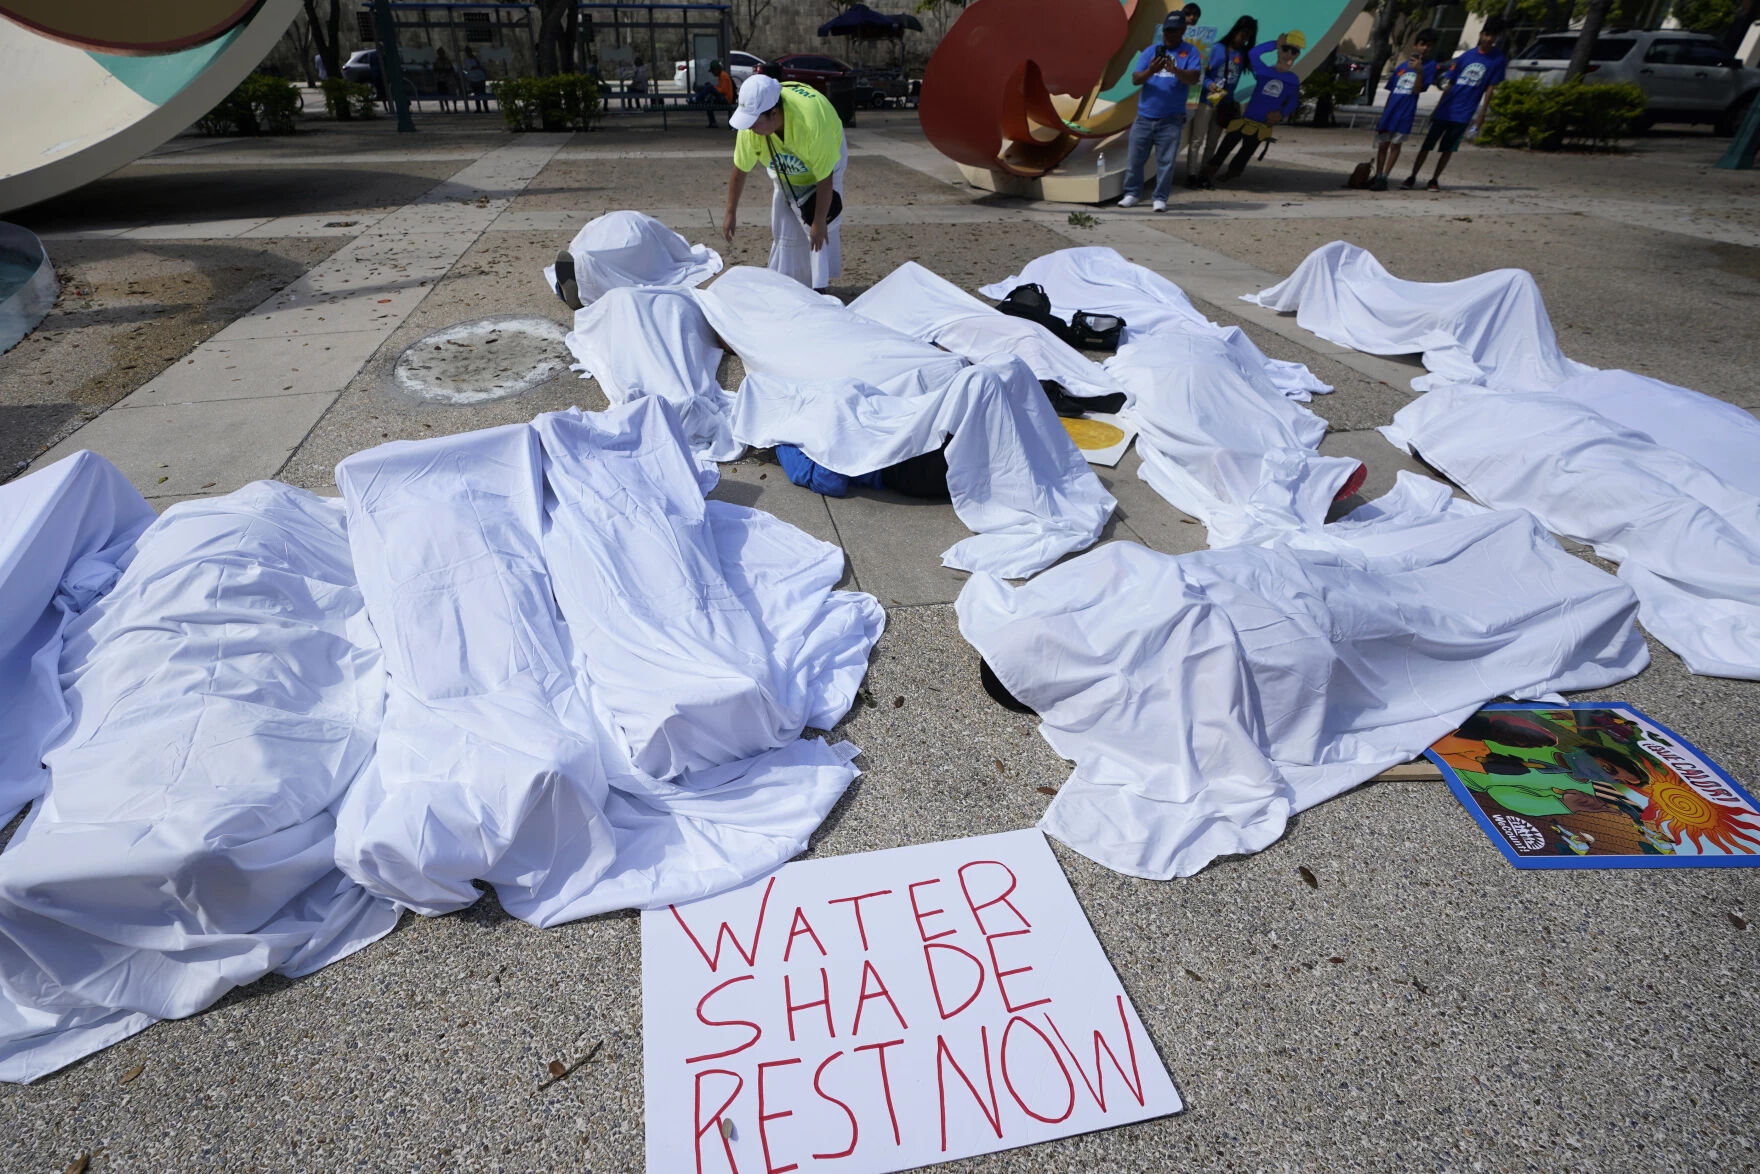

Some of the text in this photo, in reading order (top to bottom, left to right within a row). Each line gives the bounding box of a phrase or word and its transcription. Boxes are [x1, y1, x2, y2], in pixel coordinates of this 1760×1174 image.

[1671, 763, 1740, 802] CALOR!
[669, 860, 1032, 972] WATER
[685, 929, 1052, 1064] SHADE
[694, 995, 1145, 1174] REST NOW
